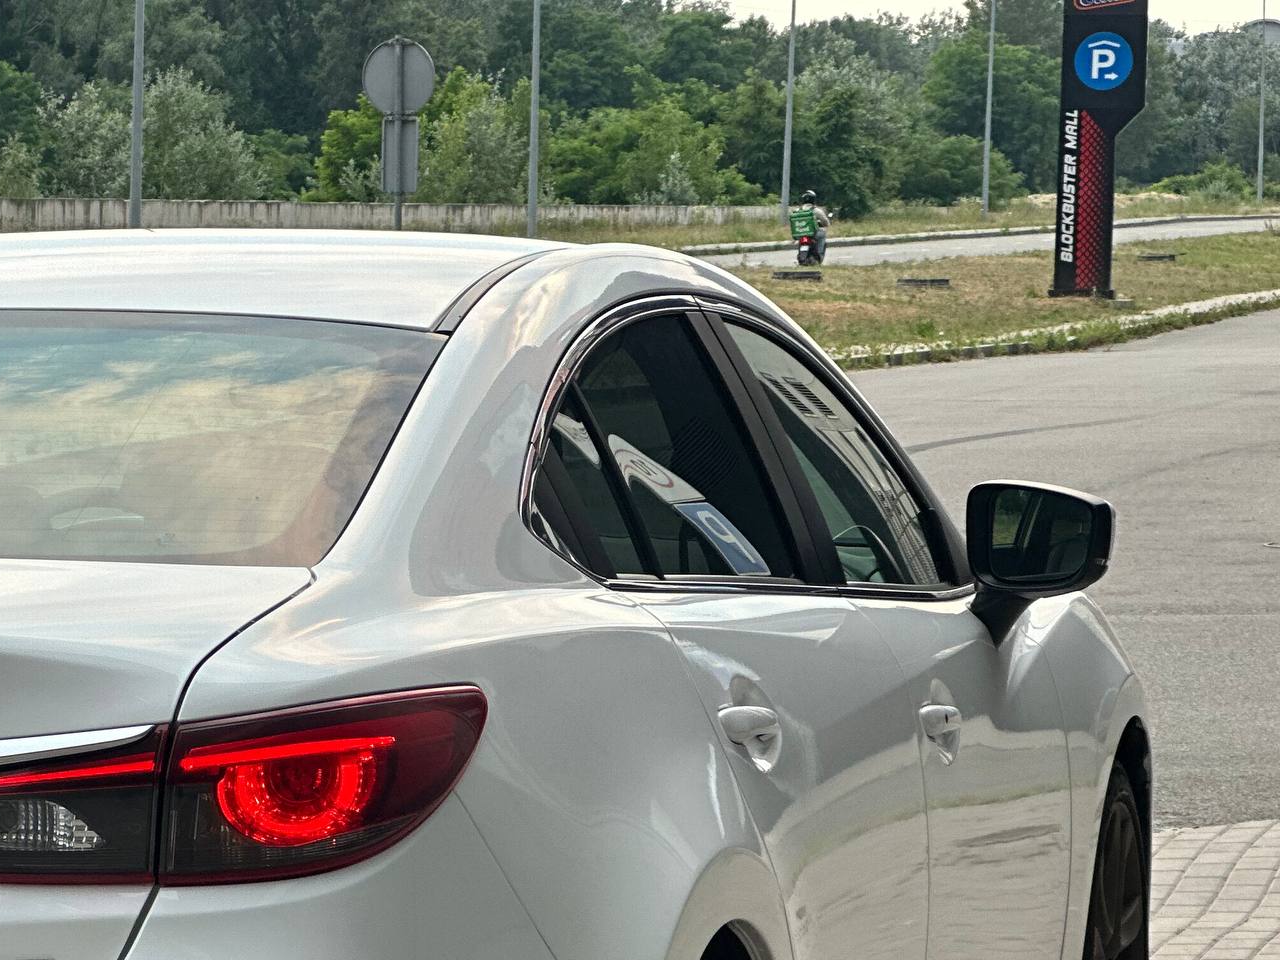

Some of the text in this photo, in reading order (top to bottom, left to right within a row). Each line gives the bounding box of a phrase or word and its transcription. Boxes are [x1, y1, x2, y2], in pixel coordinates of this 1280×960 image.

[1091, 49, 1116, 79] P
[1060, 109, 1079, 263] BLOCKBUSTER MALL
